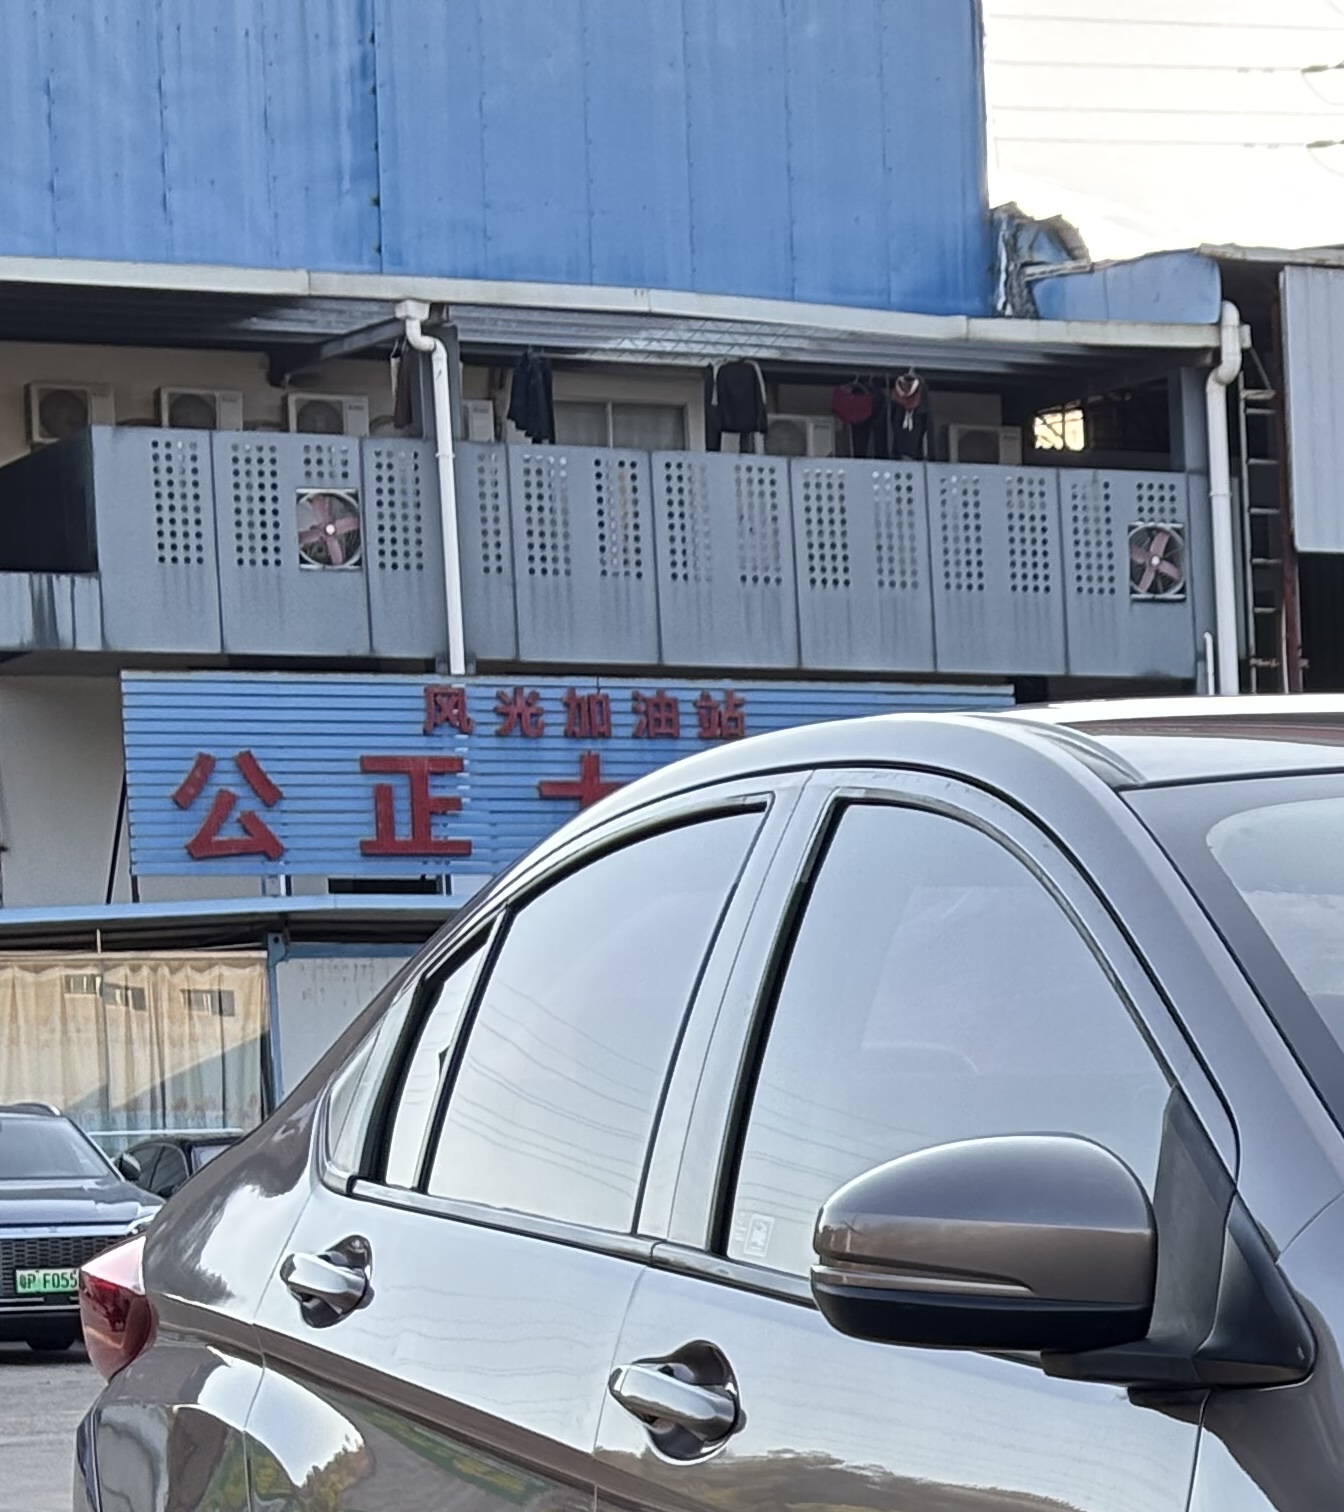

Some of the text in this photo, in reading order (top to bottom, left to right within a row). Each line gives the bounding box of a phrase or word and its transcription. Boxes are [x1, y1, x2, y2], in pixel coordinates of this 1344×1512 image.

[423, 685, 746, 738] 风光加油站
